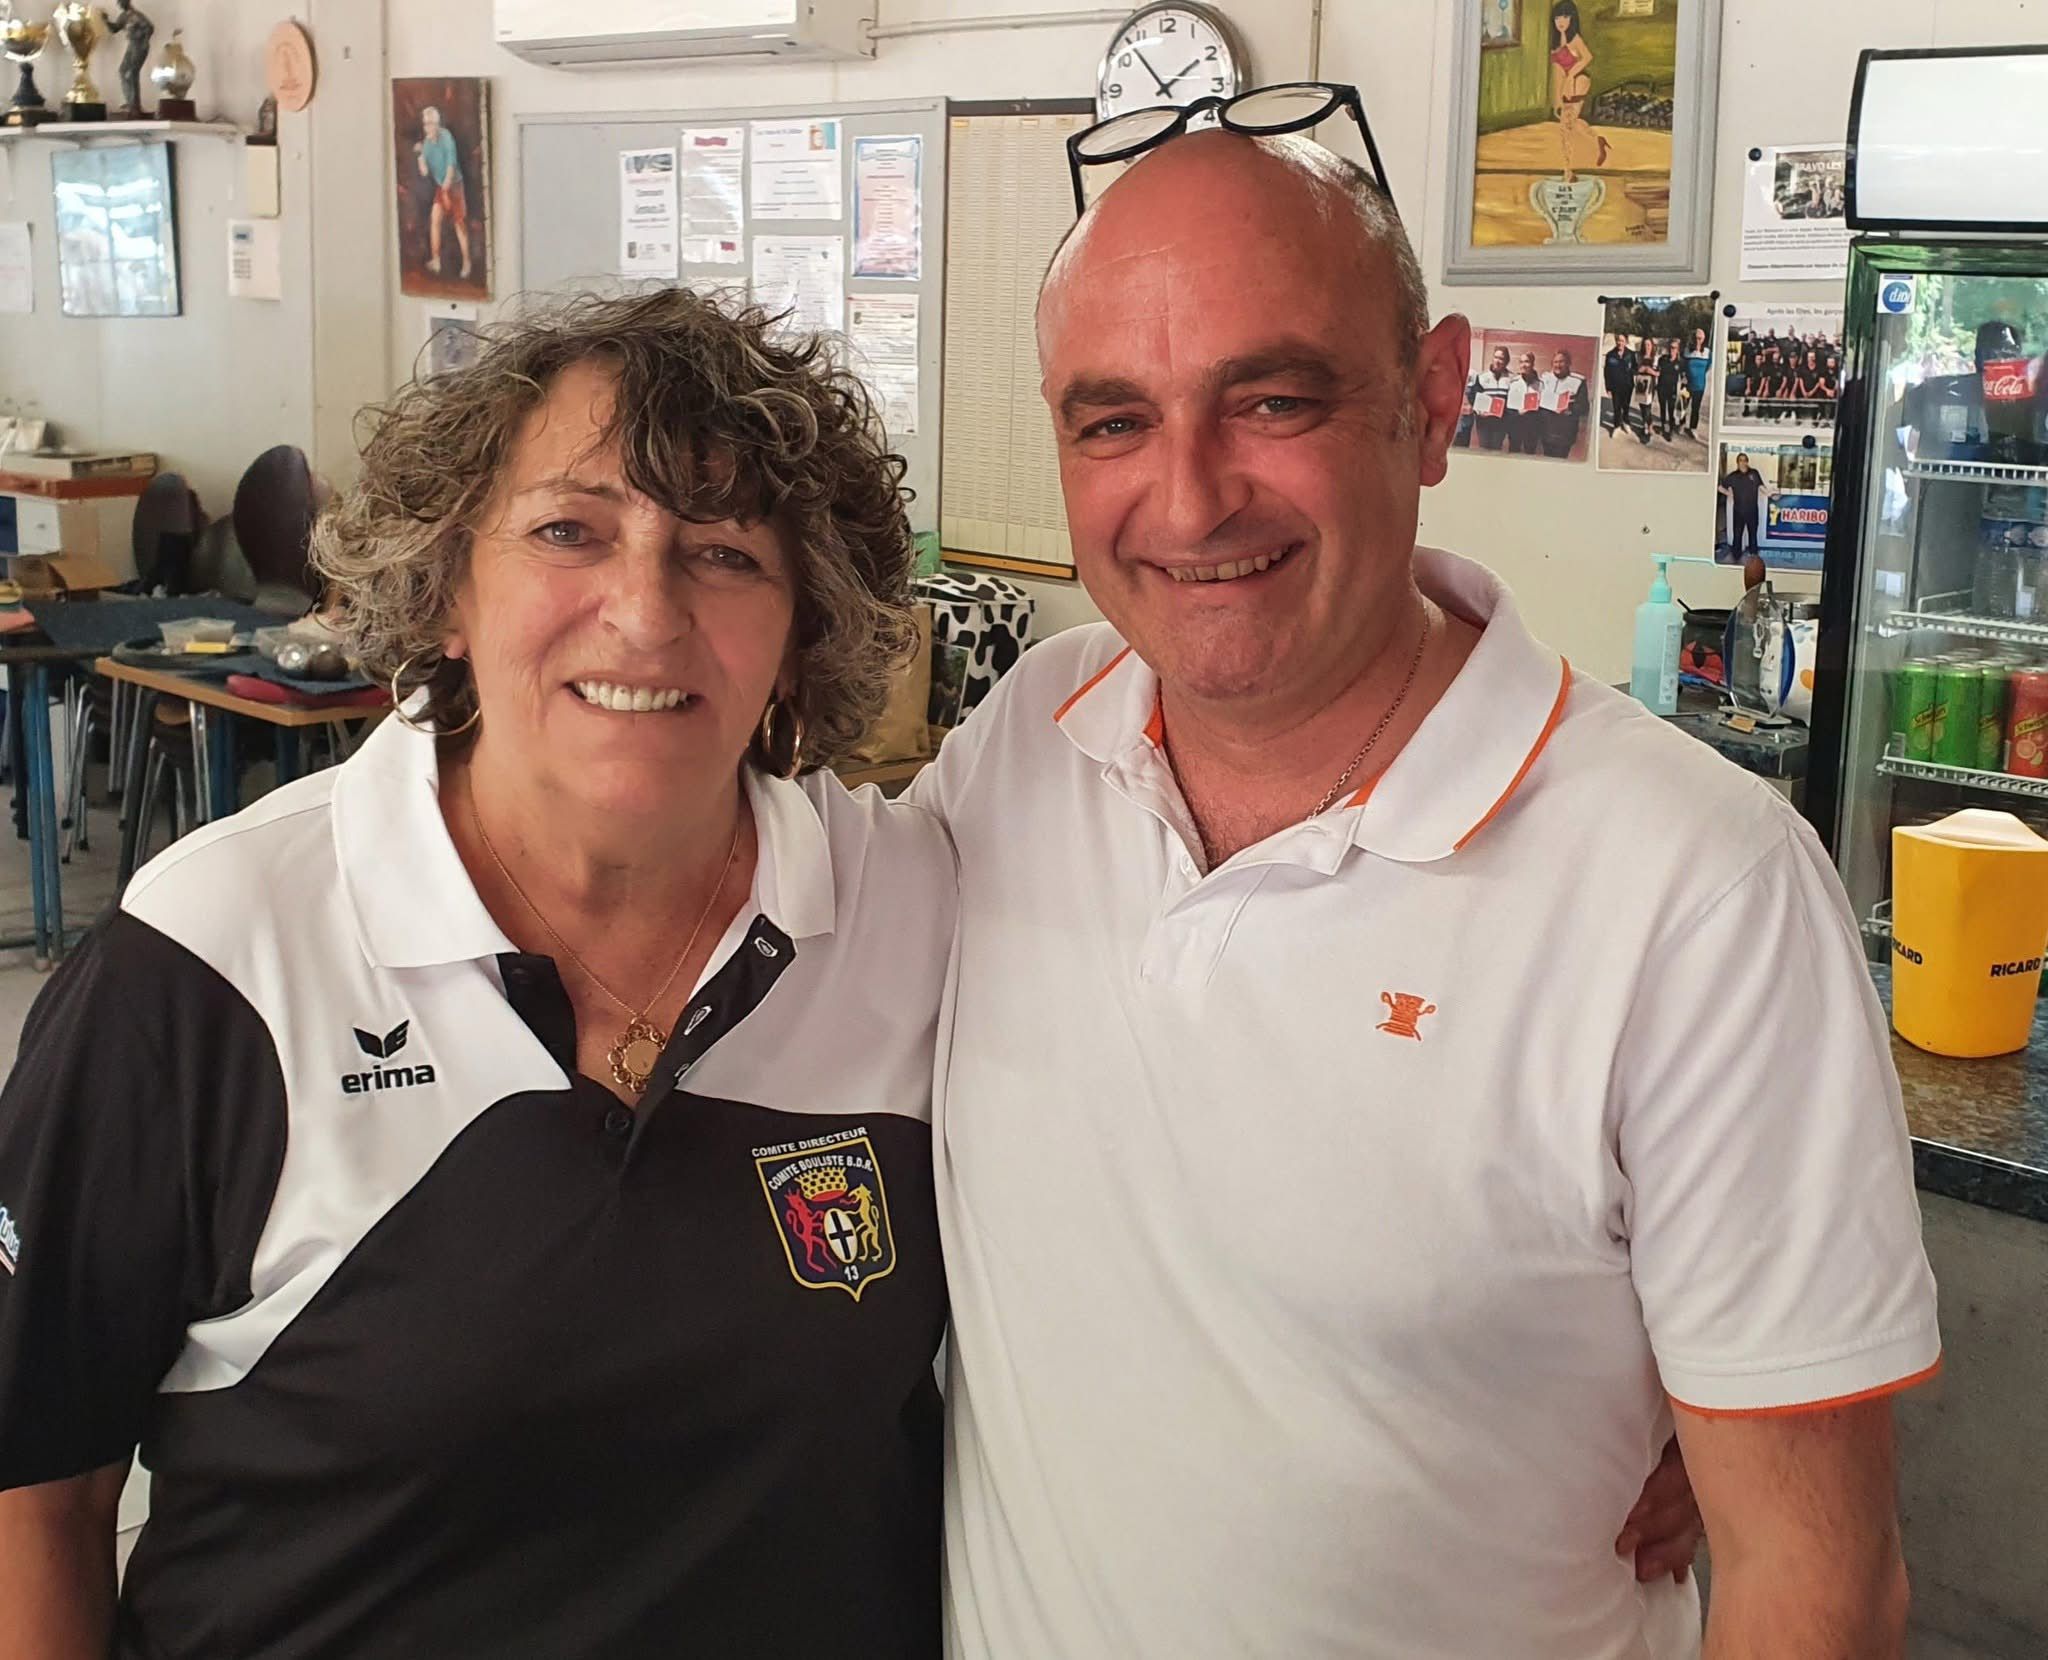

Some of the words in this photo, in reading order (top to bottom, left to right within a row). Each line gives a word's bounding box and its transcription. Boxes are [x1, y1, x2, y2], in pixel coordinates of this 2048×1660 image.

[1159, 18, 1177, 33] 12
[1190, 23, 1195, 39] 1
[1118, 53, 1132, 68] 10
[1204, 46, 1218, 61] 2
[1108, 84, 1122, 98] 9
[1210, 77, 1225, 93] 3
[1203, 108, 1216, 122] 4
[1781, 508, 1827, 524] HARIBO
[1990, 957, 2041, 977] RICARD
[341, 1064, 436, 1094] erima
[751, 1142, 797, 1158] COMITE
[798, 1126, 868, 1150] DIRECTEUR
[767, 1163, 800, 1191] COMITE
[798, 1155, 844, 1170] BOULISTE
[844, 1264, 859, 1281] 13
